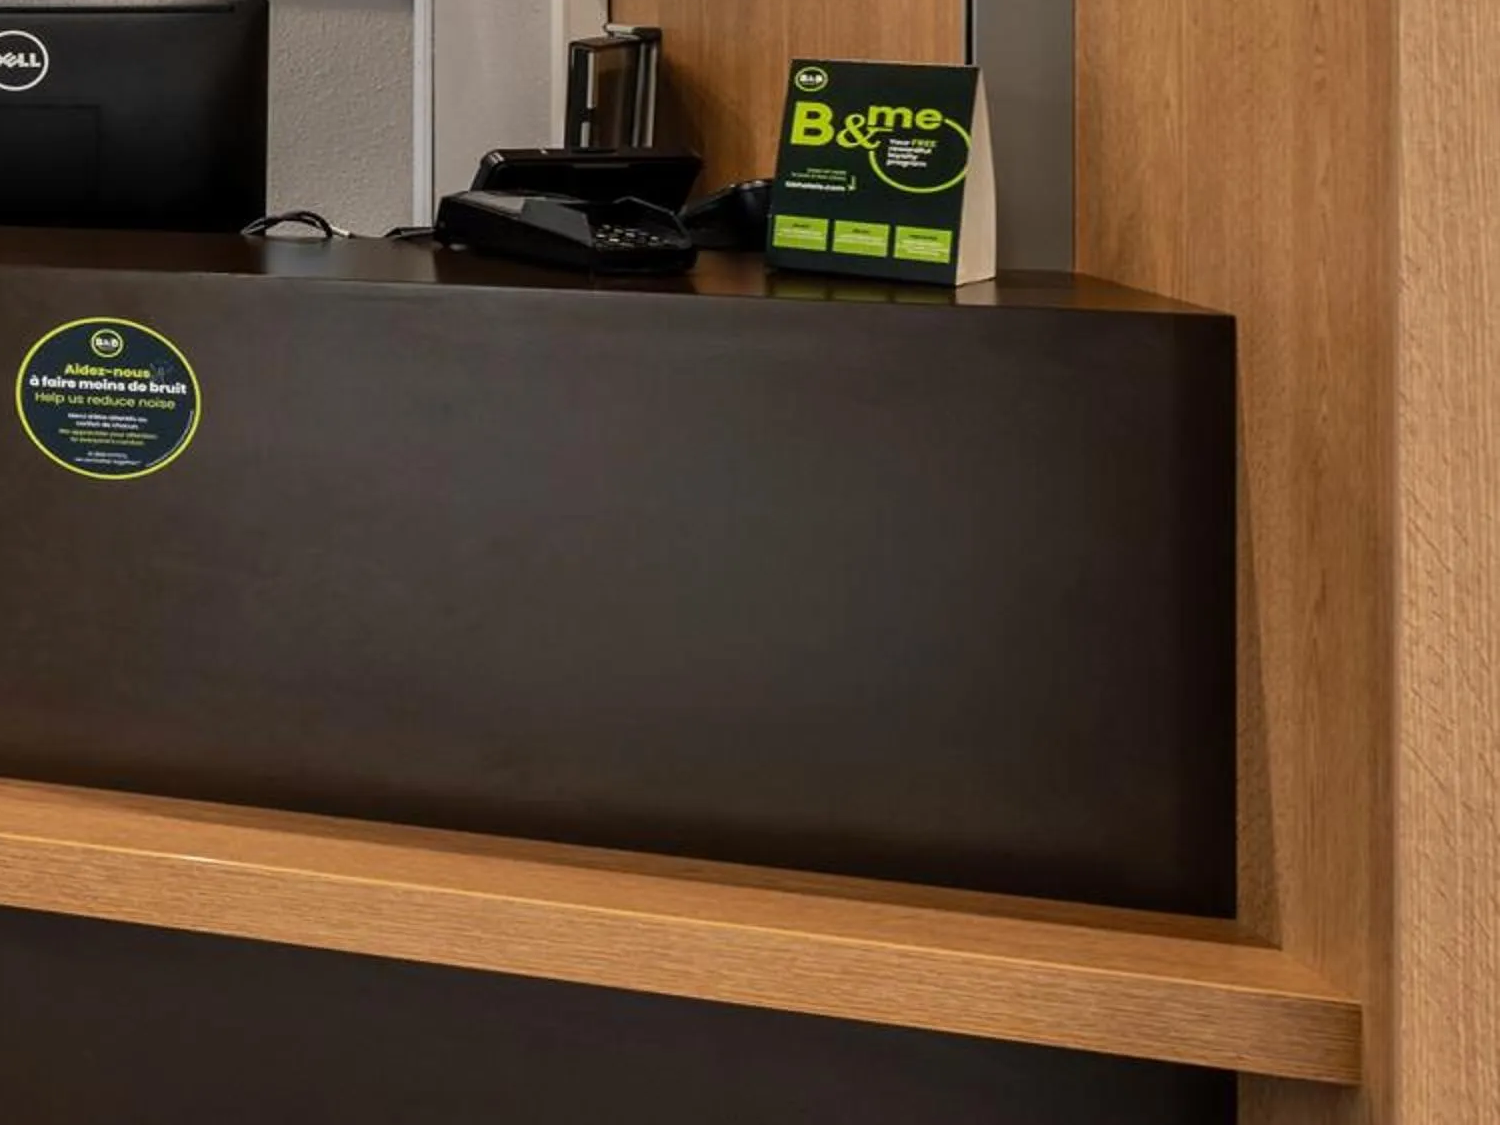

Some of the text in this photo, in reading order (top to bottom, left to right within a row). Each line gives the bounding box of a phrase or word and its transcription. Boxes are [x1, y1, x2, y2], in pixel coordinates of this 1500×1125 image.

[64, 363, 150, 379] Aidez-nous
[29, 376, 187, 395] à faire moins de bruit
[35, 392, 176, 410] Help us reduce noise
